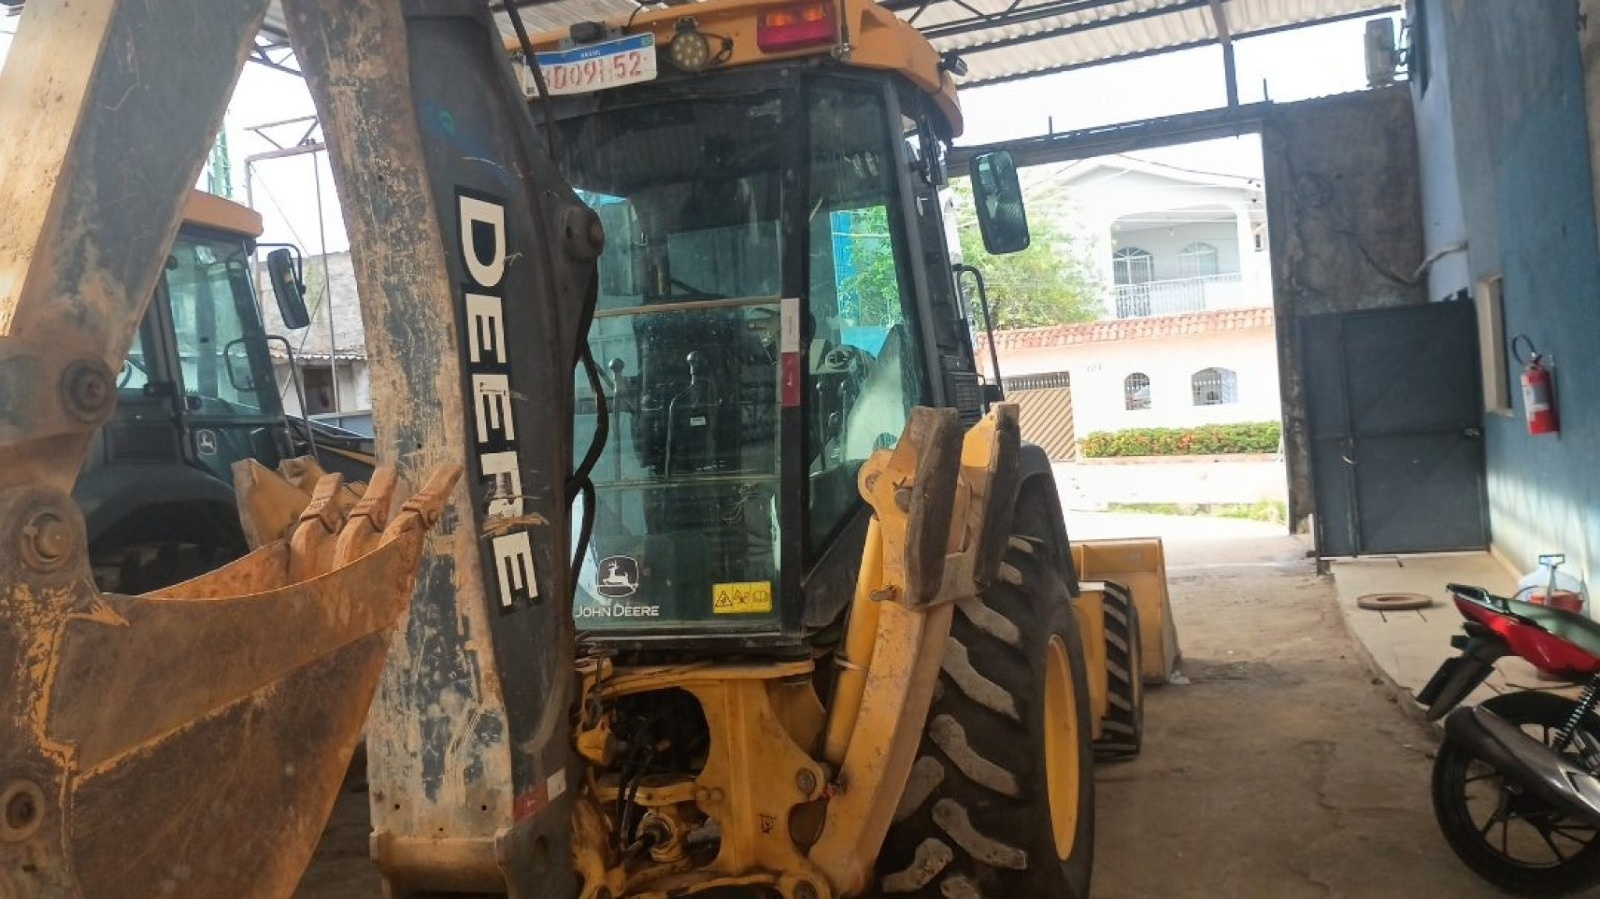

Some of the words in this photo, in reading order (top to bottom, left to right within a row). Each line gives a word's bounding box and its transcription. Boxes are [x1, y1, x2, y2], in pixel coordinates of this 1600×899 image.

[459, 196, 539, 608] DEERE
[576, 605, 611, 618] JOHN
[616, 604, 660, 617] DEERE
